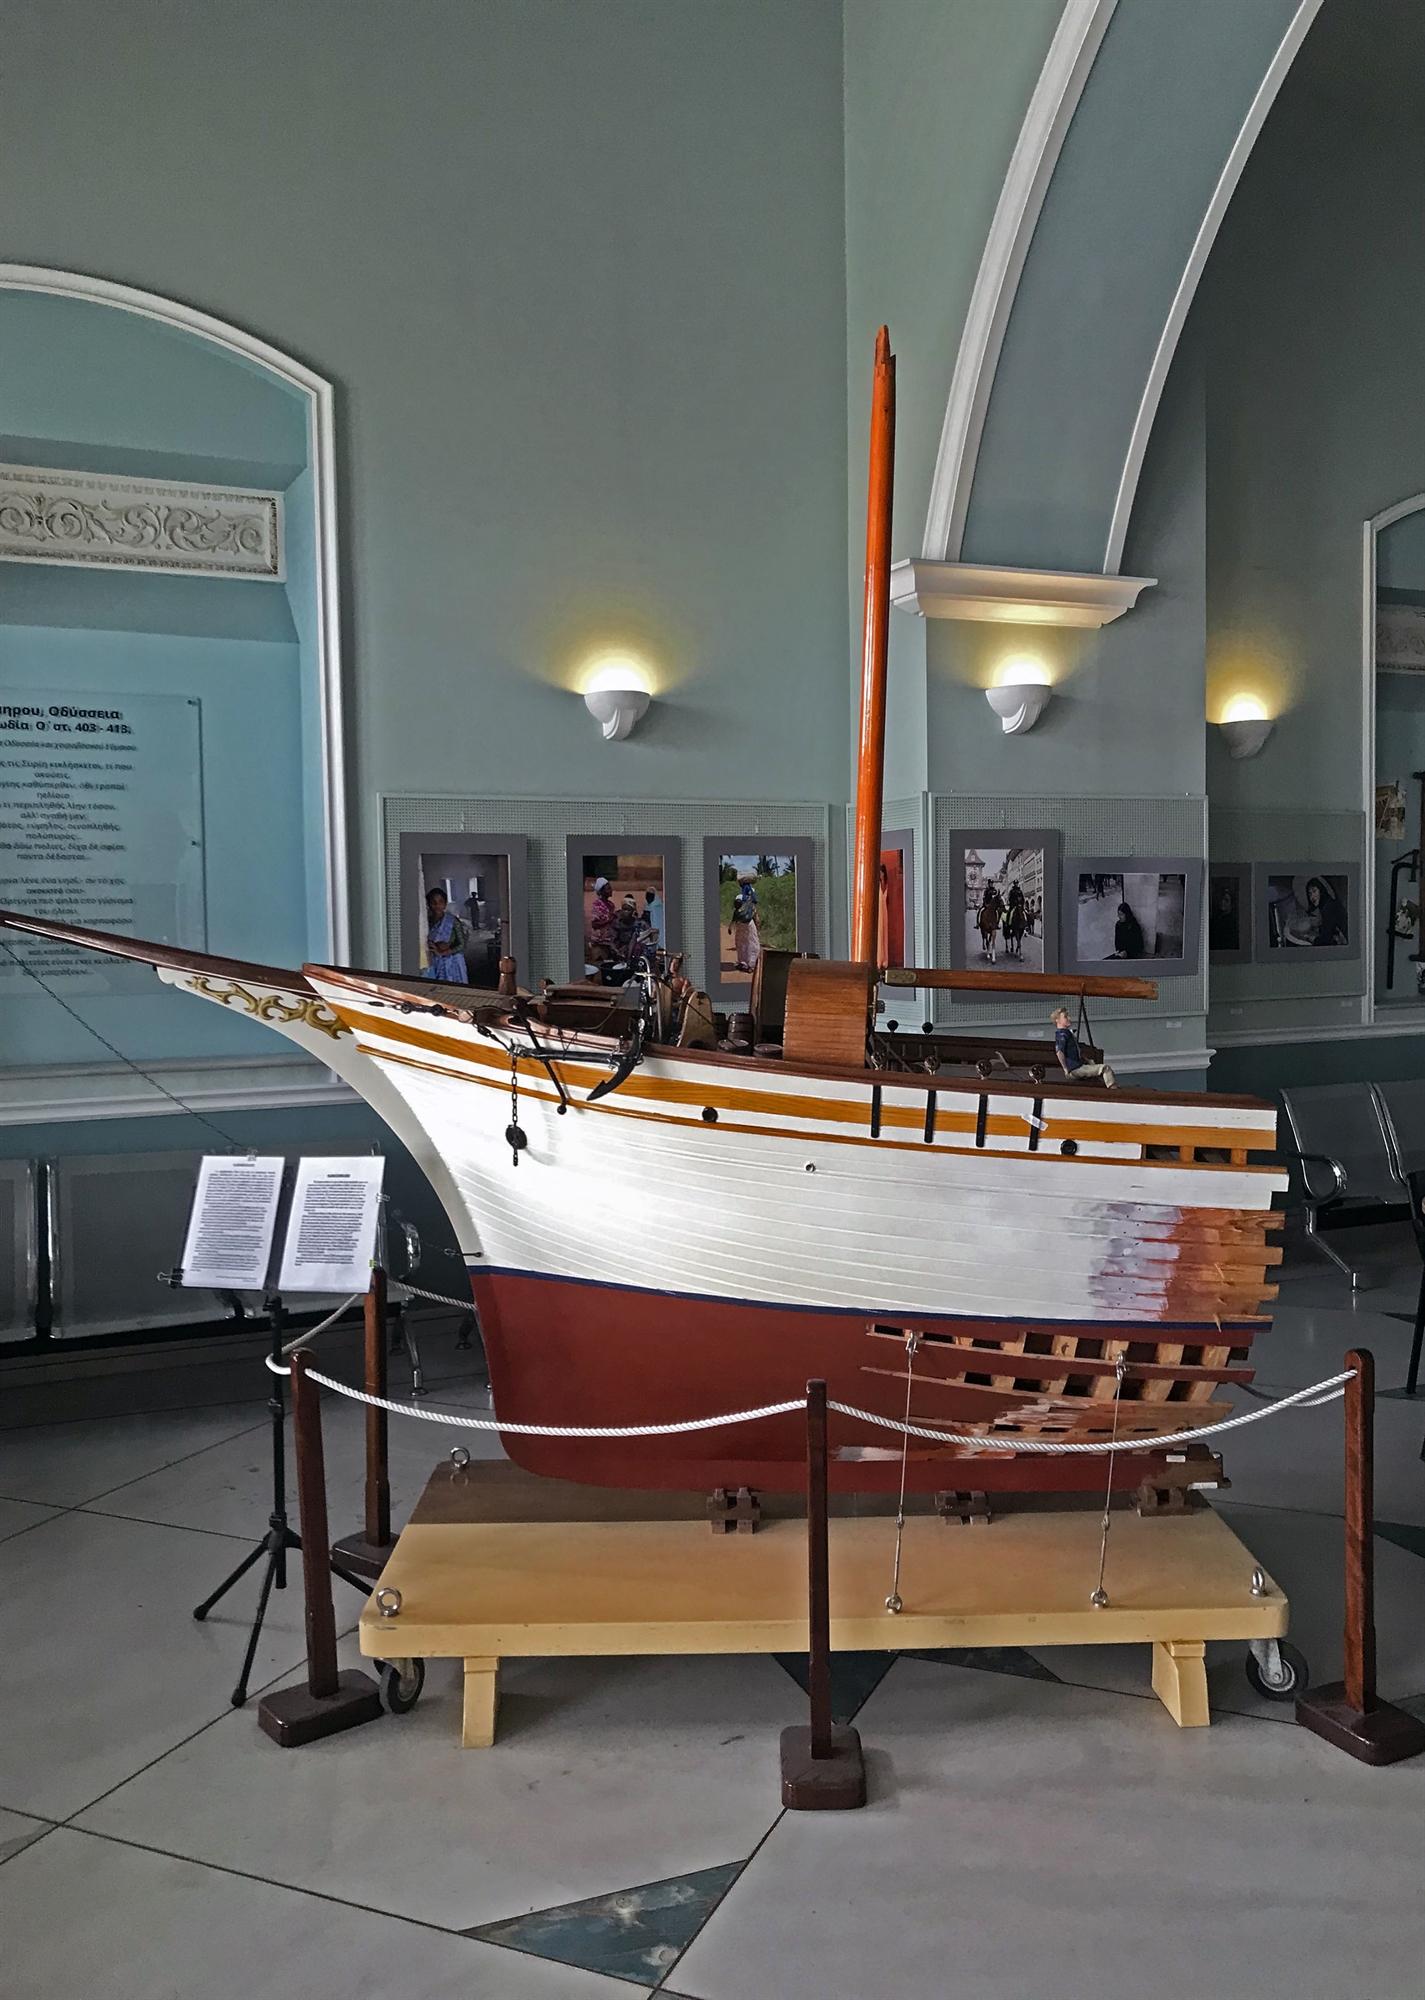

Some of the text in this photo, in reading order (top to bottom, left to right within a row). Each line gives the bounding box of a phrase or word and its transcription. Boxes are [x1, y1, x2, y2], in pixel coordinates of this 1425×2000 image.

[0, 705, 120, 720] ηρου, Οδύσσεια
[75, 722, 97, 733] 403
